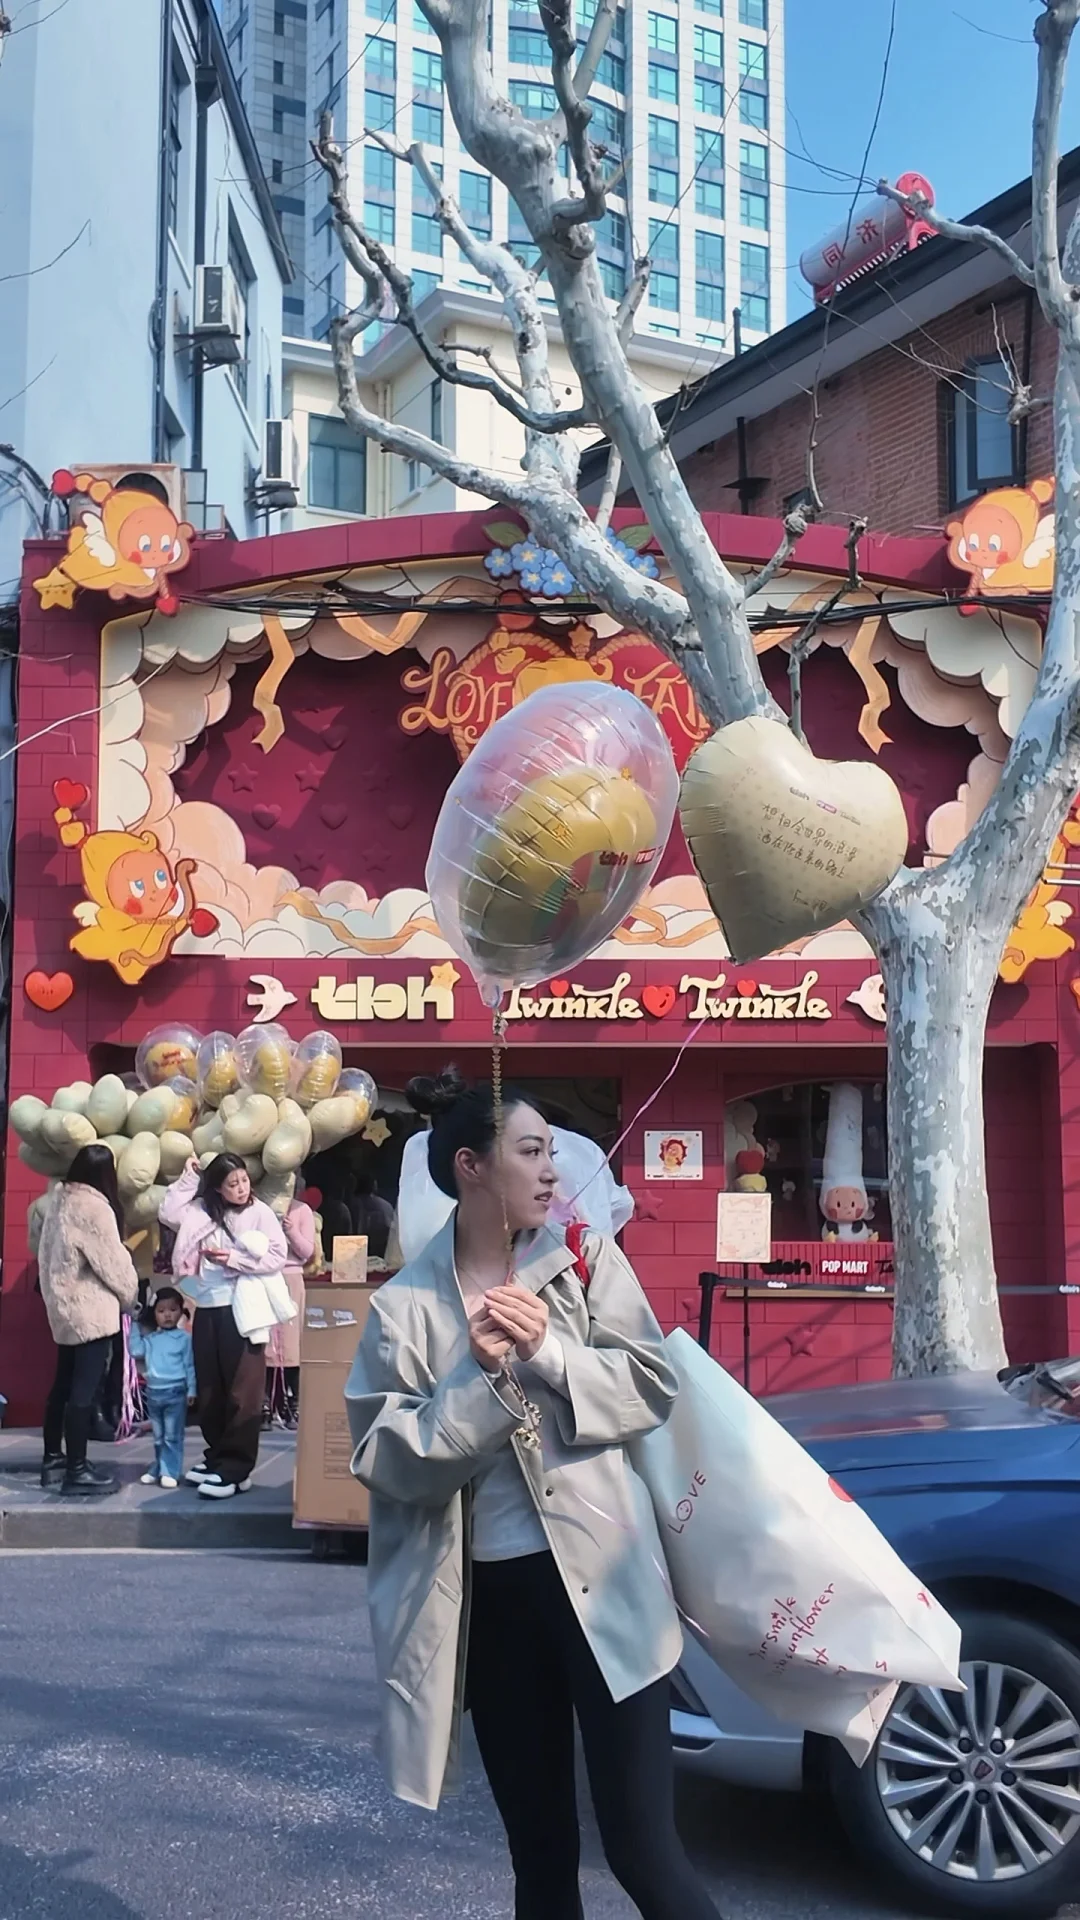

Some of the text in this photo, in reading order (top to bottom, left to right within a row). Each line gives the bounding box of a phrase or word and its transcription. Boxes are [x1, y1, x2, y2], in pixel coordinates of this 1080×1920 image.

[502, 972, 644, 1019] Twinkle
[679, 970, 833, 1019] Twinkle
[821, 1260, 841, 1274] POP
[842, 1260, 869, 1274] MART
[667, 1470, 707, 1534] LOVE
